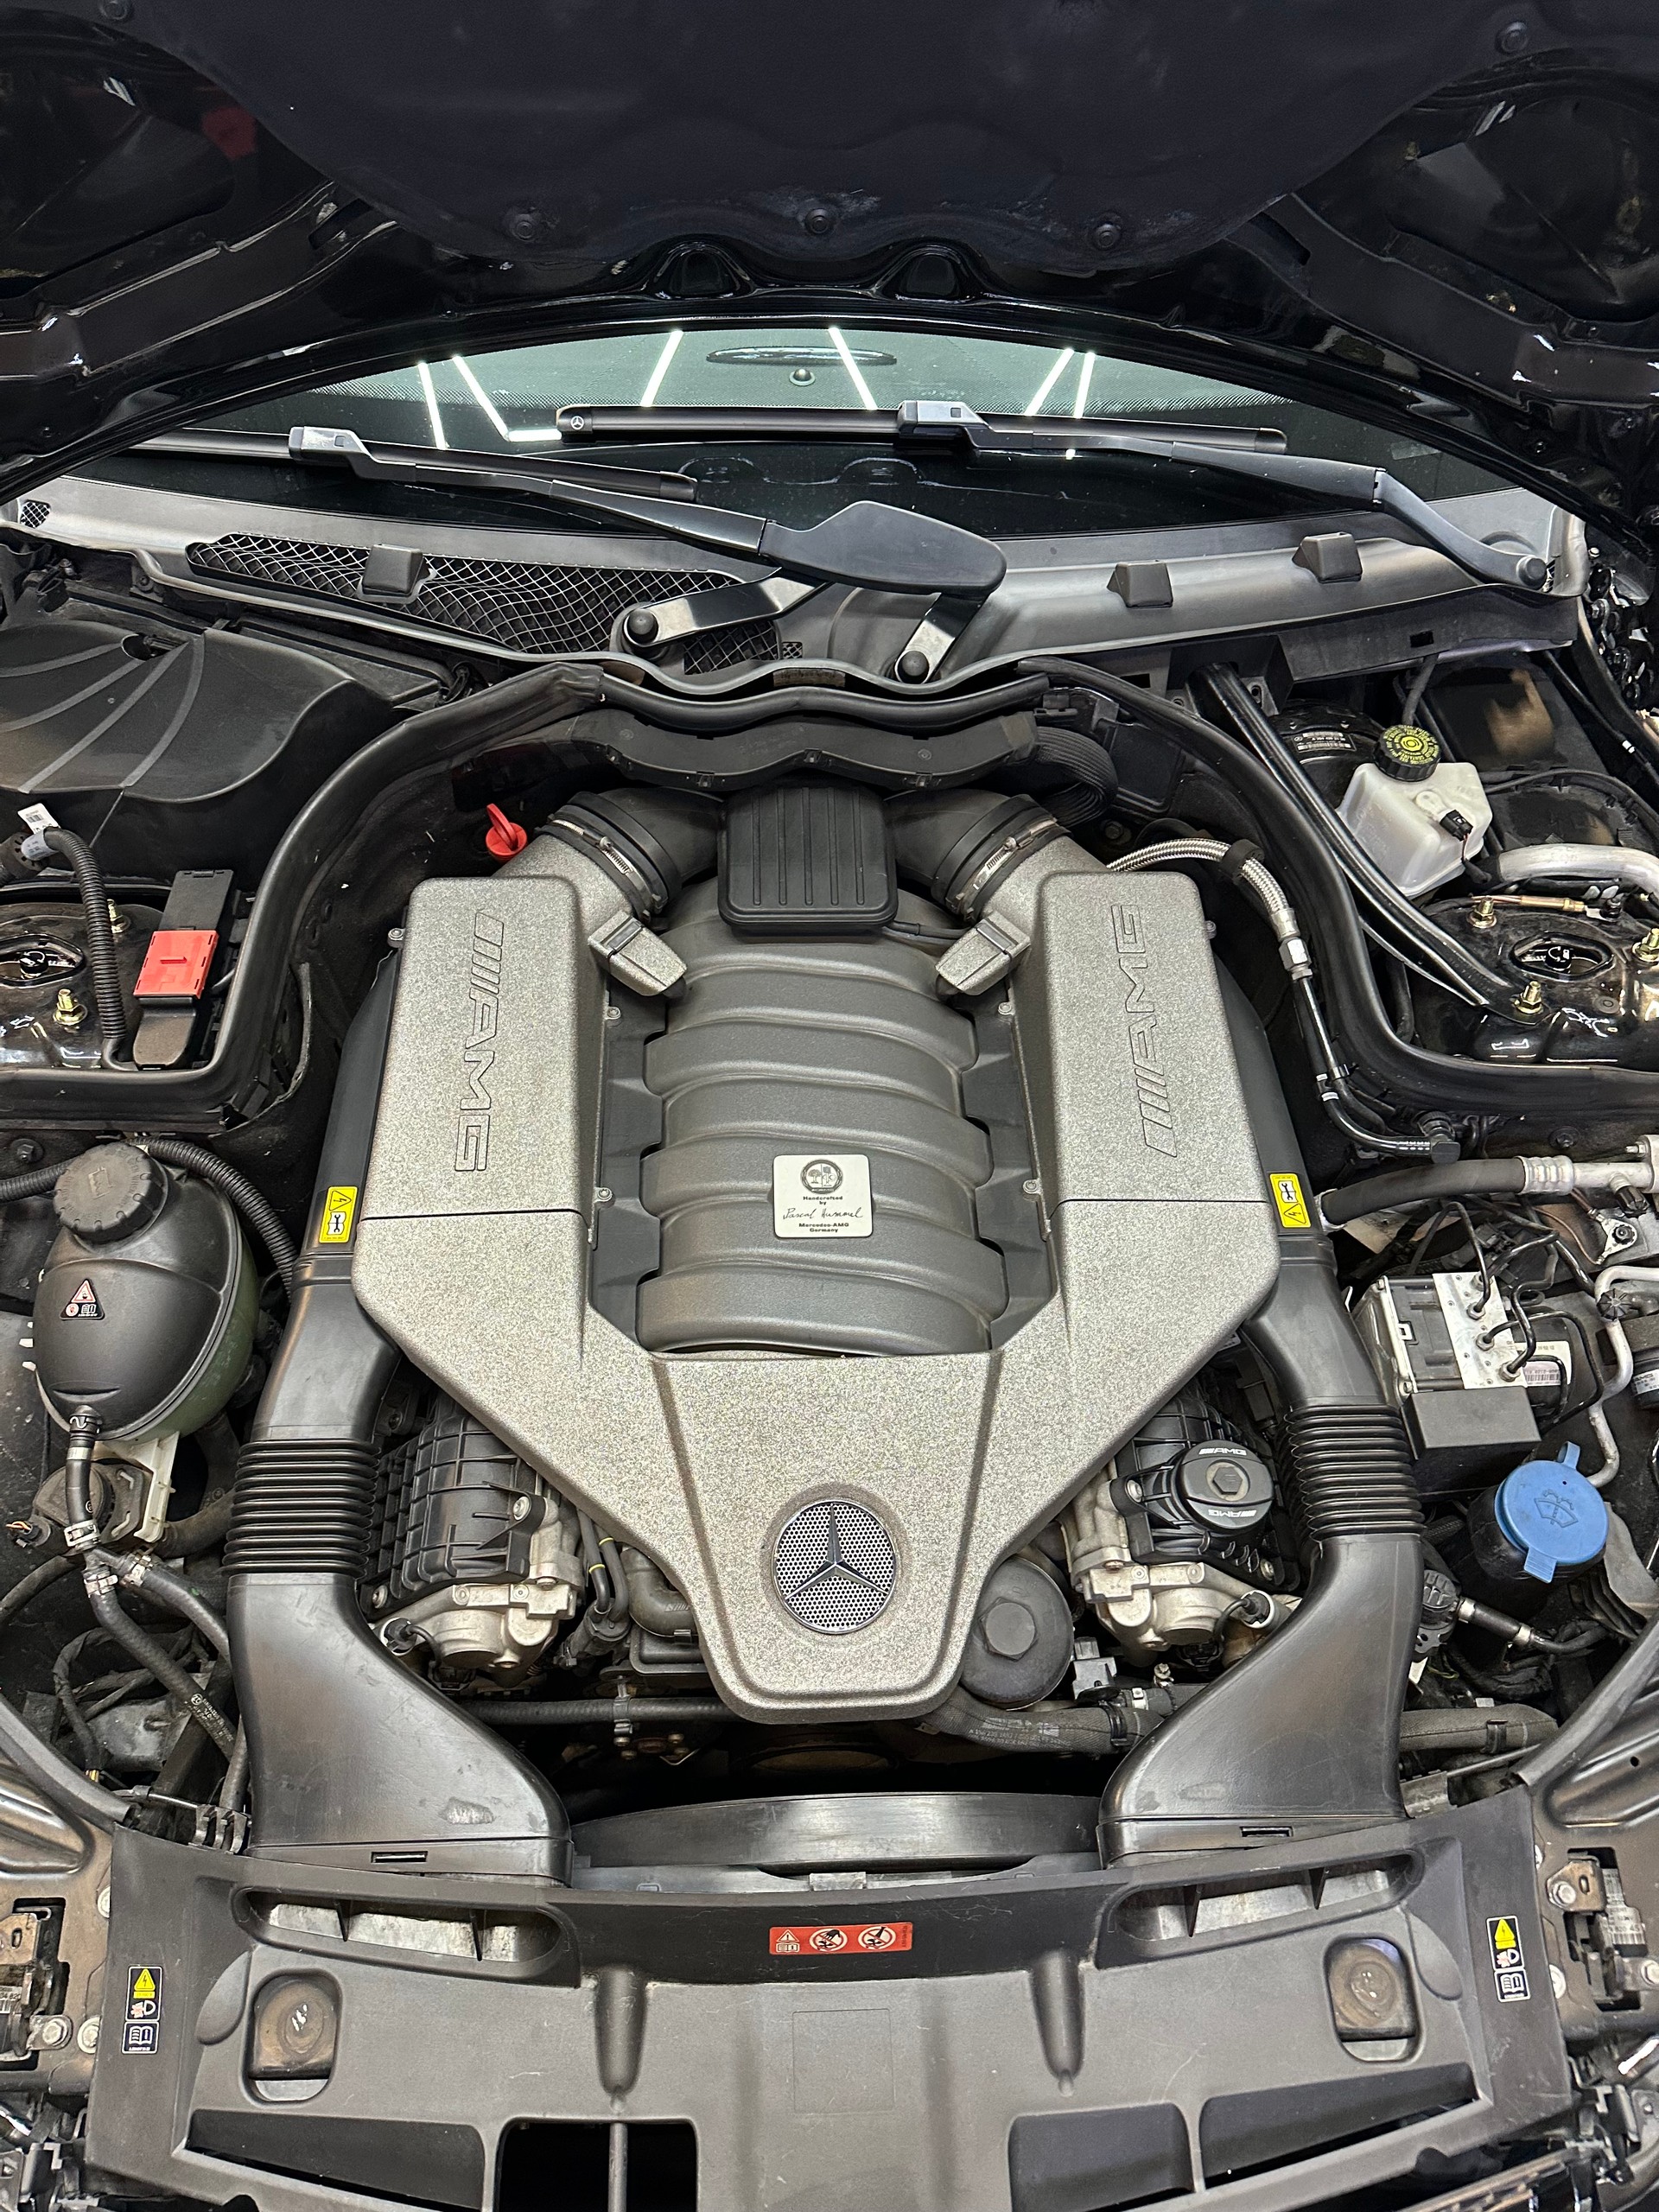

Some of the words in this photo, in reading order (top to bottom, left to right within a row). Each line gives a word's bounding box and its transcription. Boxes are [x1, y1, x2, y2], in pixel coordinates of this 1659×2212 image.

[1110, 905, 1165, 1077] AMG
[454, 988, 499, 1172] AMG
[1213, 1447, 1247, 1456] AMG
[1208, 1509, 1243, 1518] AMG
